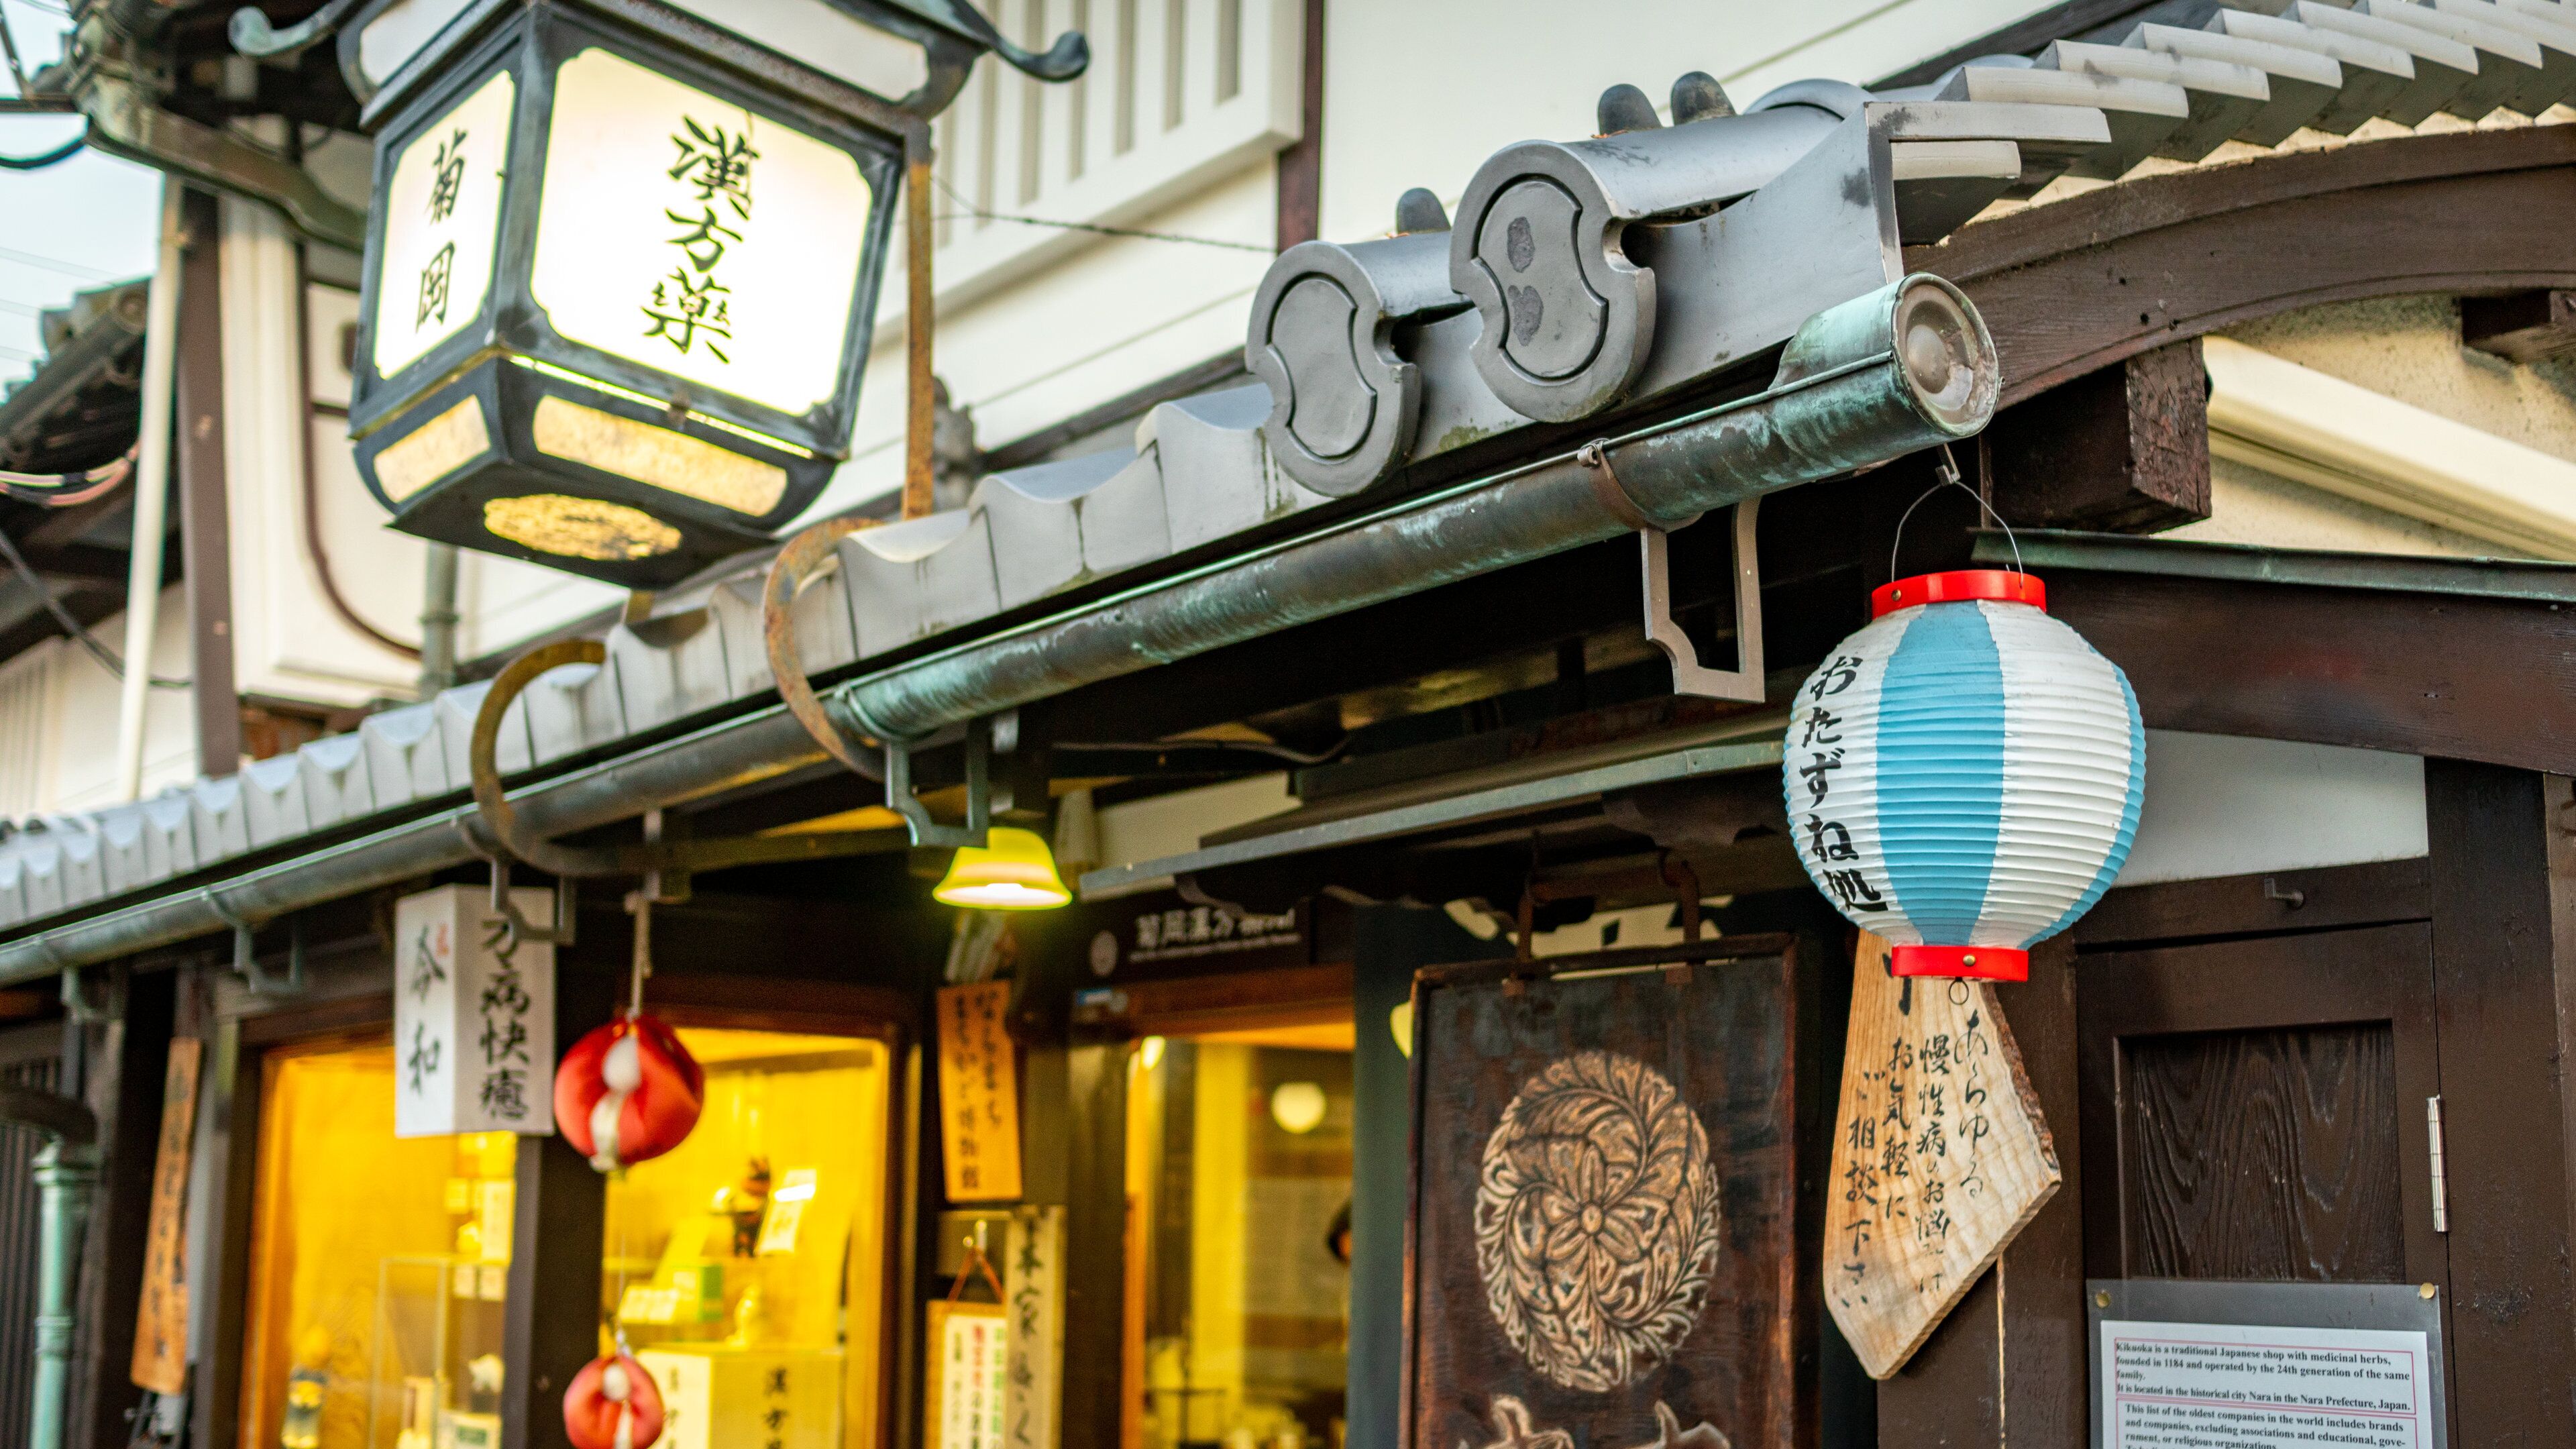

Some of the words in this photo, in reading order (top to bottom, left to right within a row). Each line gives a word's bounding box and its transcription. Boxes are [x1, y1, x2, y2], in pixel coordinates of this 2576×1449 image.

[416, 129, 468, 332] 菊岡
[1799, 655, 1889, 912] おたずね処
[2116, 1343, 2152, 1353] Kikuoka
[2155, 1344, 2161, 1353] is
[2171, 1346, 2217, 1356] traditional
[2220, 1348, 2260, 1359] Japanese
[2263, 1350, 2284, 1361] shop
[2288, 1350, 2307, 1360] with
[2311, 1352, 2357, 1363] medicinal
[2361, 1354, 2391, 1365] herbs,
[2116, 1356, 2150, 1366] founded
[2153, 1358, 2161, 1367] in
[2165, 1358, 2183, 1368] 1184
[2186, 1360, 2202, 1369] and
[2205, 1361, 2244, 1372] operated
[2247, 1363, 2257, 1375] by
[2261, 1364, 2274, 1374] the
[2277, 1365, 2297, 1375] 24th
[2300, 1367, 2351, 1378] generation
[2354, 1368, 2363, 1378] of
[2366, 1371, 2381, 1379] the
[2384, 1372, 2410, 1381] same
[2126, 1384, 2133, 1393] is
[2134, 1384, 2163, 1395] located
[2165, 1385, 2174, 1395] in
[2176, 1387, 2189, 1396] the
[2191, 1387, 2229, 1399] historical
[2231, 1390, 2247, 1403] city
[2250, 1391, 2271, 1402] Nara
[2274, 1393, 2281, 1402] in
[2284, 1394, 2298, 1403] the
[2300, 1395, 2323, 1405] Nara
[2326, 1396, 2376, 1409] Prefecture,
[2378, 1399, 2410, 1411] Japan.
[2126, 1403, 2144, 1413] This
[2147, 1404, 2159, 1415] list
[2162, 1406, 2171, 1415] of
[2173, 1407, 2187, 1417] the
[2189, 1408, 2214, 1418] oldest
[2217, 1411, 2265, 1422] companies
[2268, 1413, 2276, 1423] in
[2279, 1414, 2294, 1424] the
[2296, 1416, 2324, 1426] world
[2326, 1417, 2366, 1429] includes
[2369, 1420, 2404, 1432] brands
[2125, 1419, 2141, 1427] and
[2195, 1423, 2238, 1436] excluding
[2241, 1427, 2295, 1439] associations
[2297, 1430, 2314, 1440] and
[2318, 1432, 2377, 1446] educational,
[2174, 1436, 2212, 1447] religious
